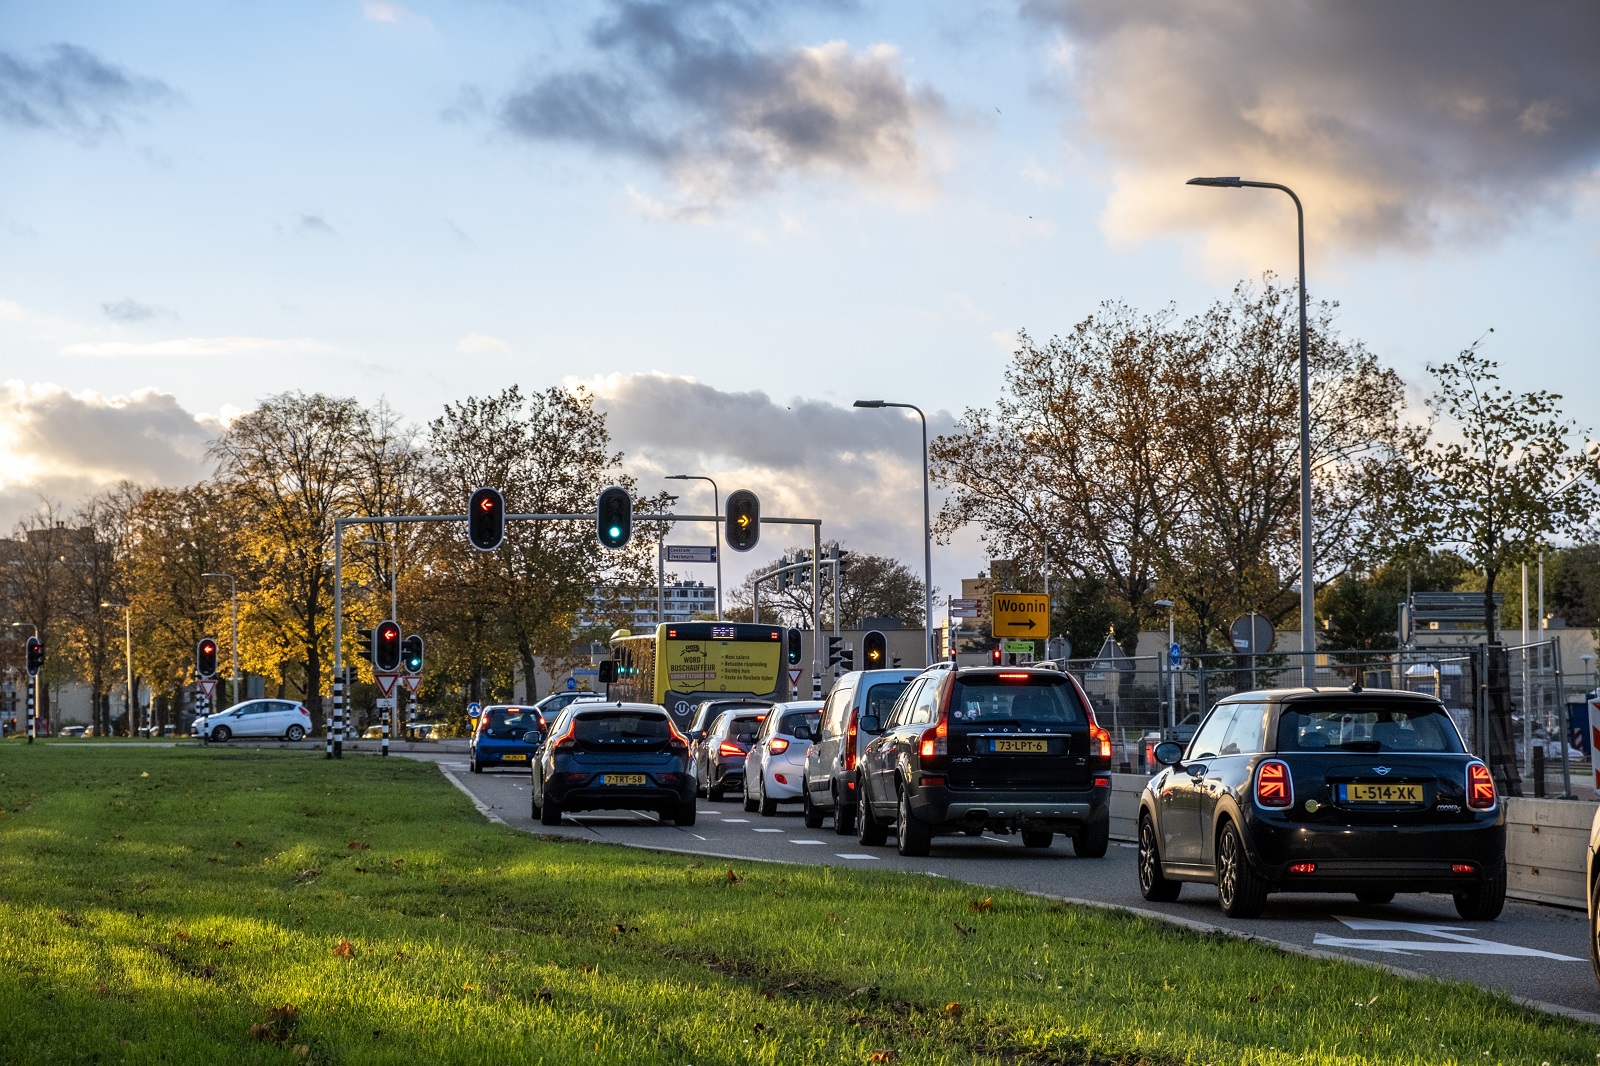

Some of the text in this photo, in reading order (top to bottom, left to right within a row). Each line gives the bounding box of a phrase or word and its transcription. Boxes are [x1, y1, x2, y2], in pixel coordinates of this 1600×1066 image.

[997, 599, 1046, 613] Woonin
[683, 656, 701, 664] WORD
[999, 741, 1043, 751] 73-LPT-6
[606, 775, 643, 783] 7-TRT-58
[1354, 786, 1417, 800] L-514-XK
